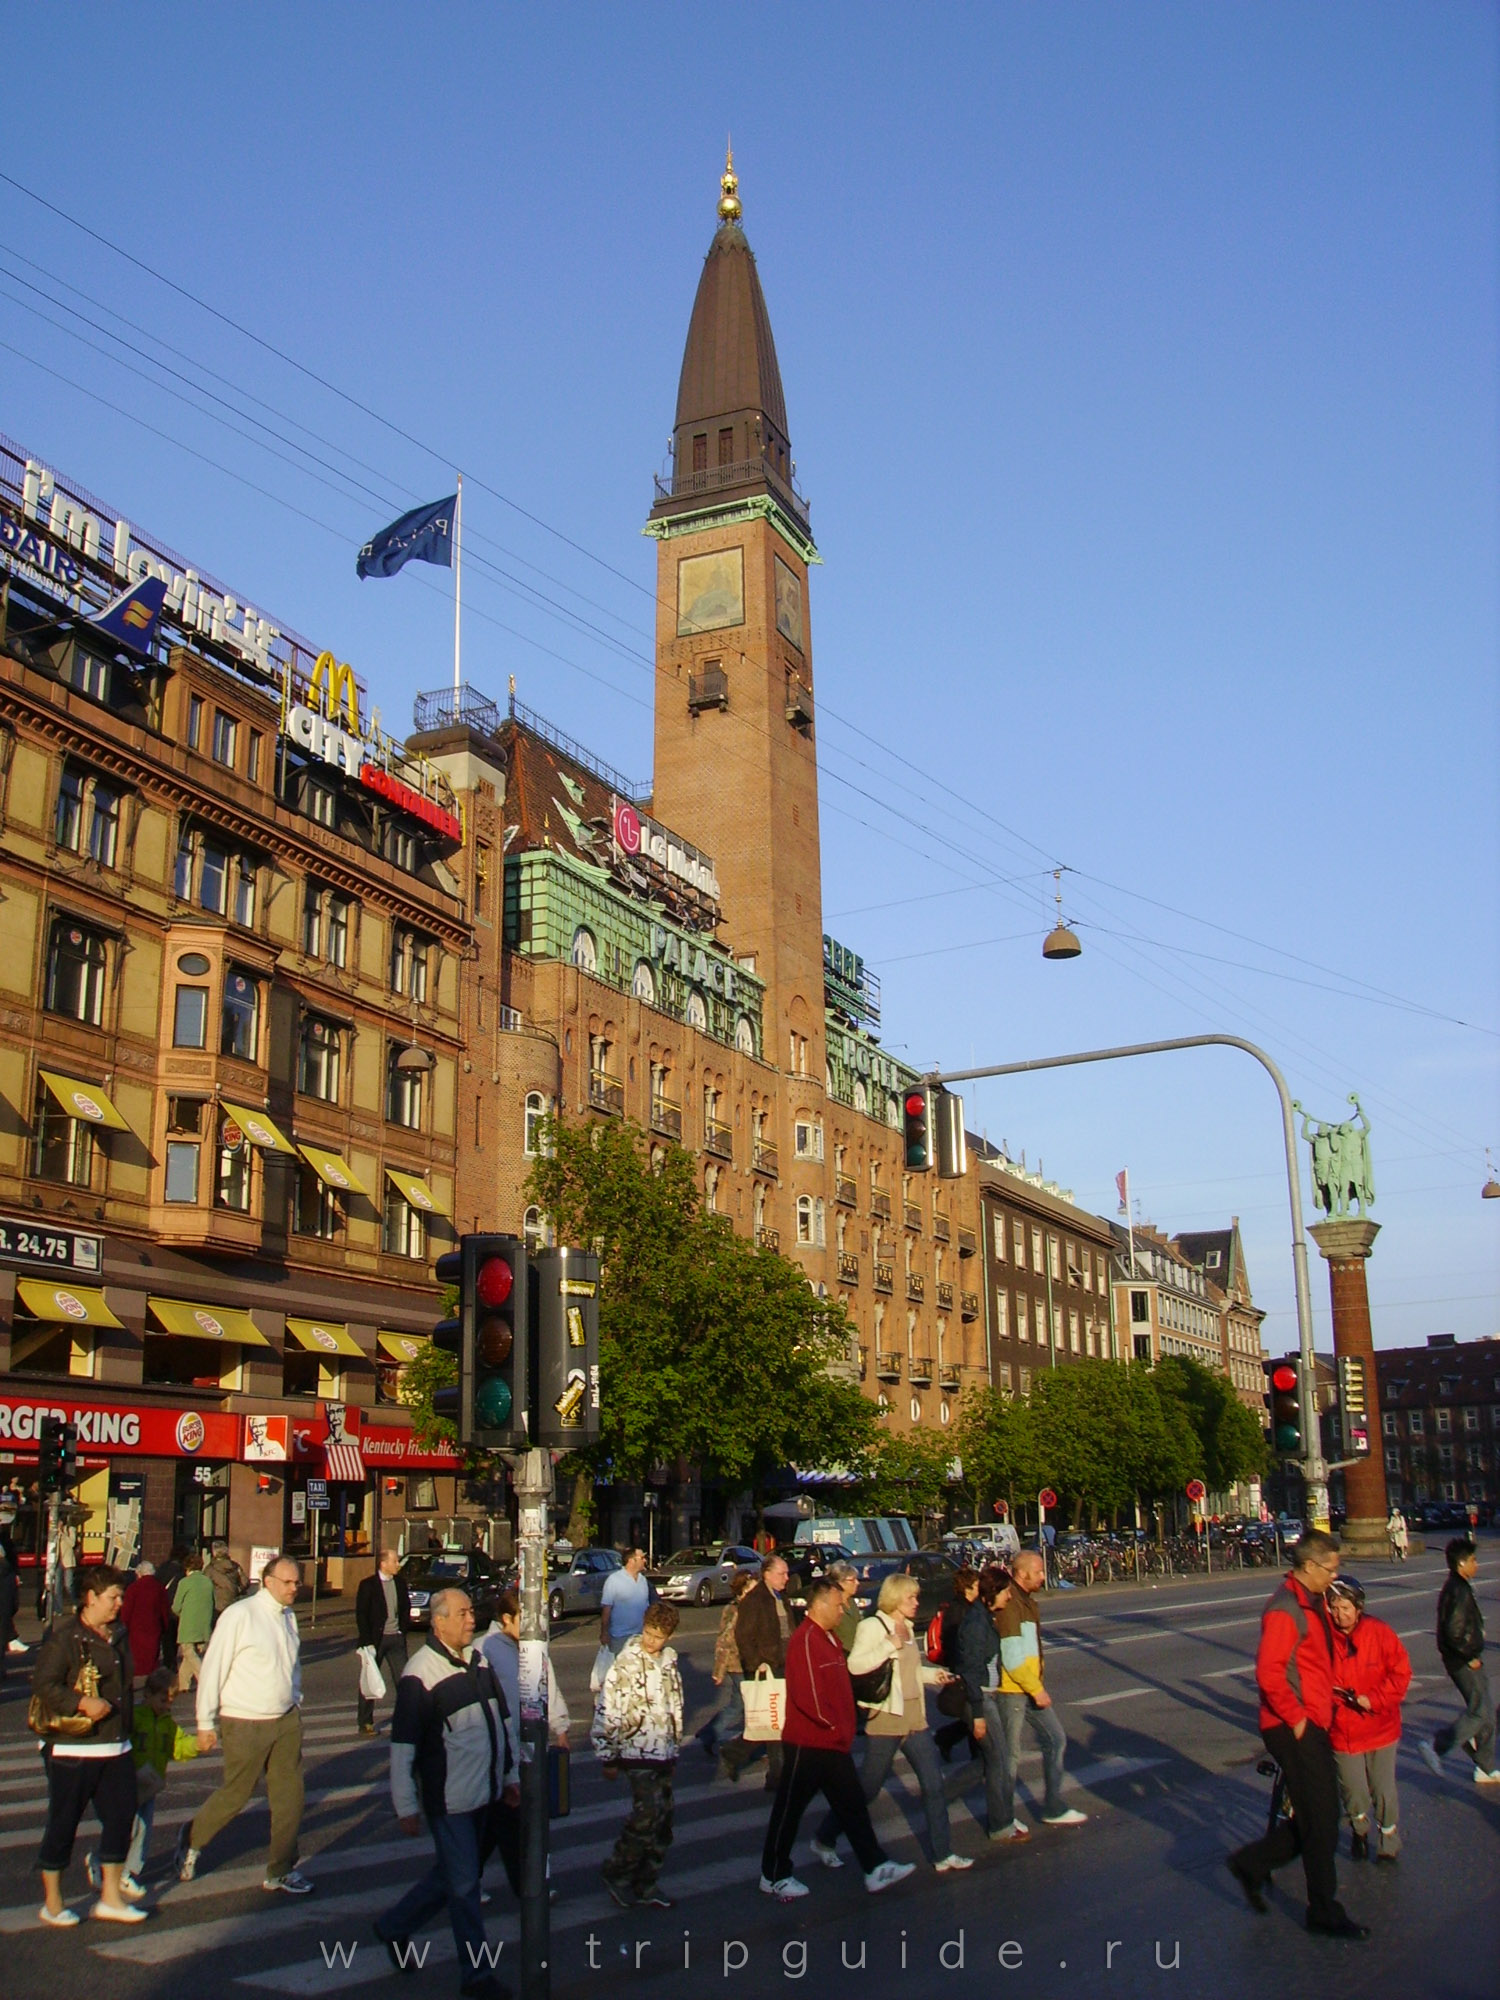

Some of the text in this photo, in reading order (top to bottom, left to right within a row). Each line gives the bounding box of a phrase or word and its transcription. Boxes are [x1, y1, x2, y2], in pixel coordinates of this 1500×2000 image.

[23, 459, 101, 562] i'm
[113, 520, 237, 644] lovin'
[289, 705, 365, 780] CITY
[640, 826, 720, 901] LG Mobile
[650, 922, 740, 1003] PALACE
[842, 1035, 905, 1095] HOTEL
[17, 1232, 67, 1259] 24,75
[73, 1410, 140, 1446] KING
[182, 1427, 203, 1444] KING
[362, 1437, 406, 1460] Kentucky
[194, 1466, 212, 1482] 55
[309, 1482, 326, 1492] TAXI
[769, 1692, 781, 1731] home
